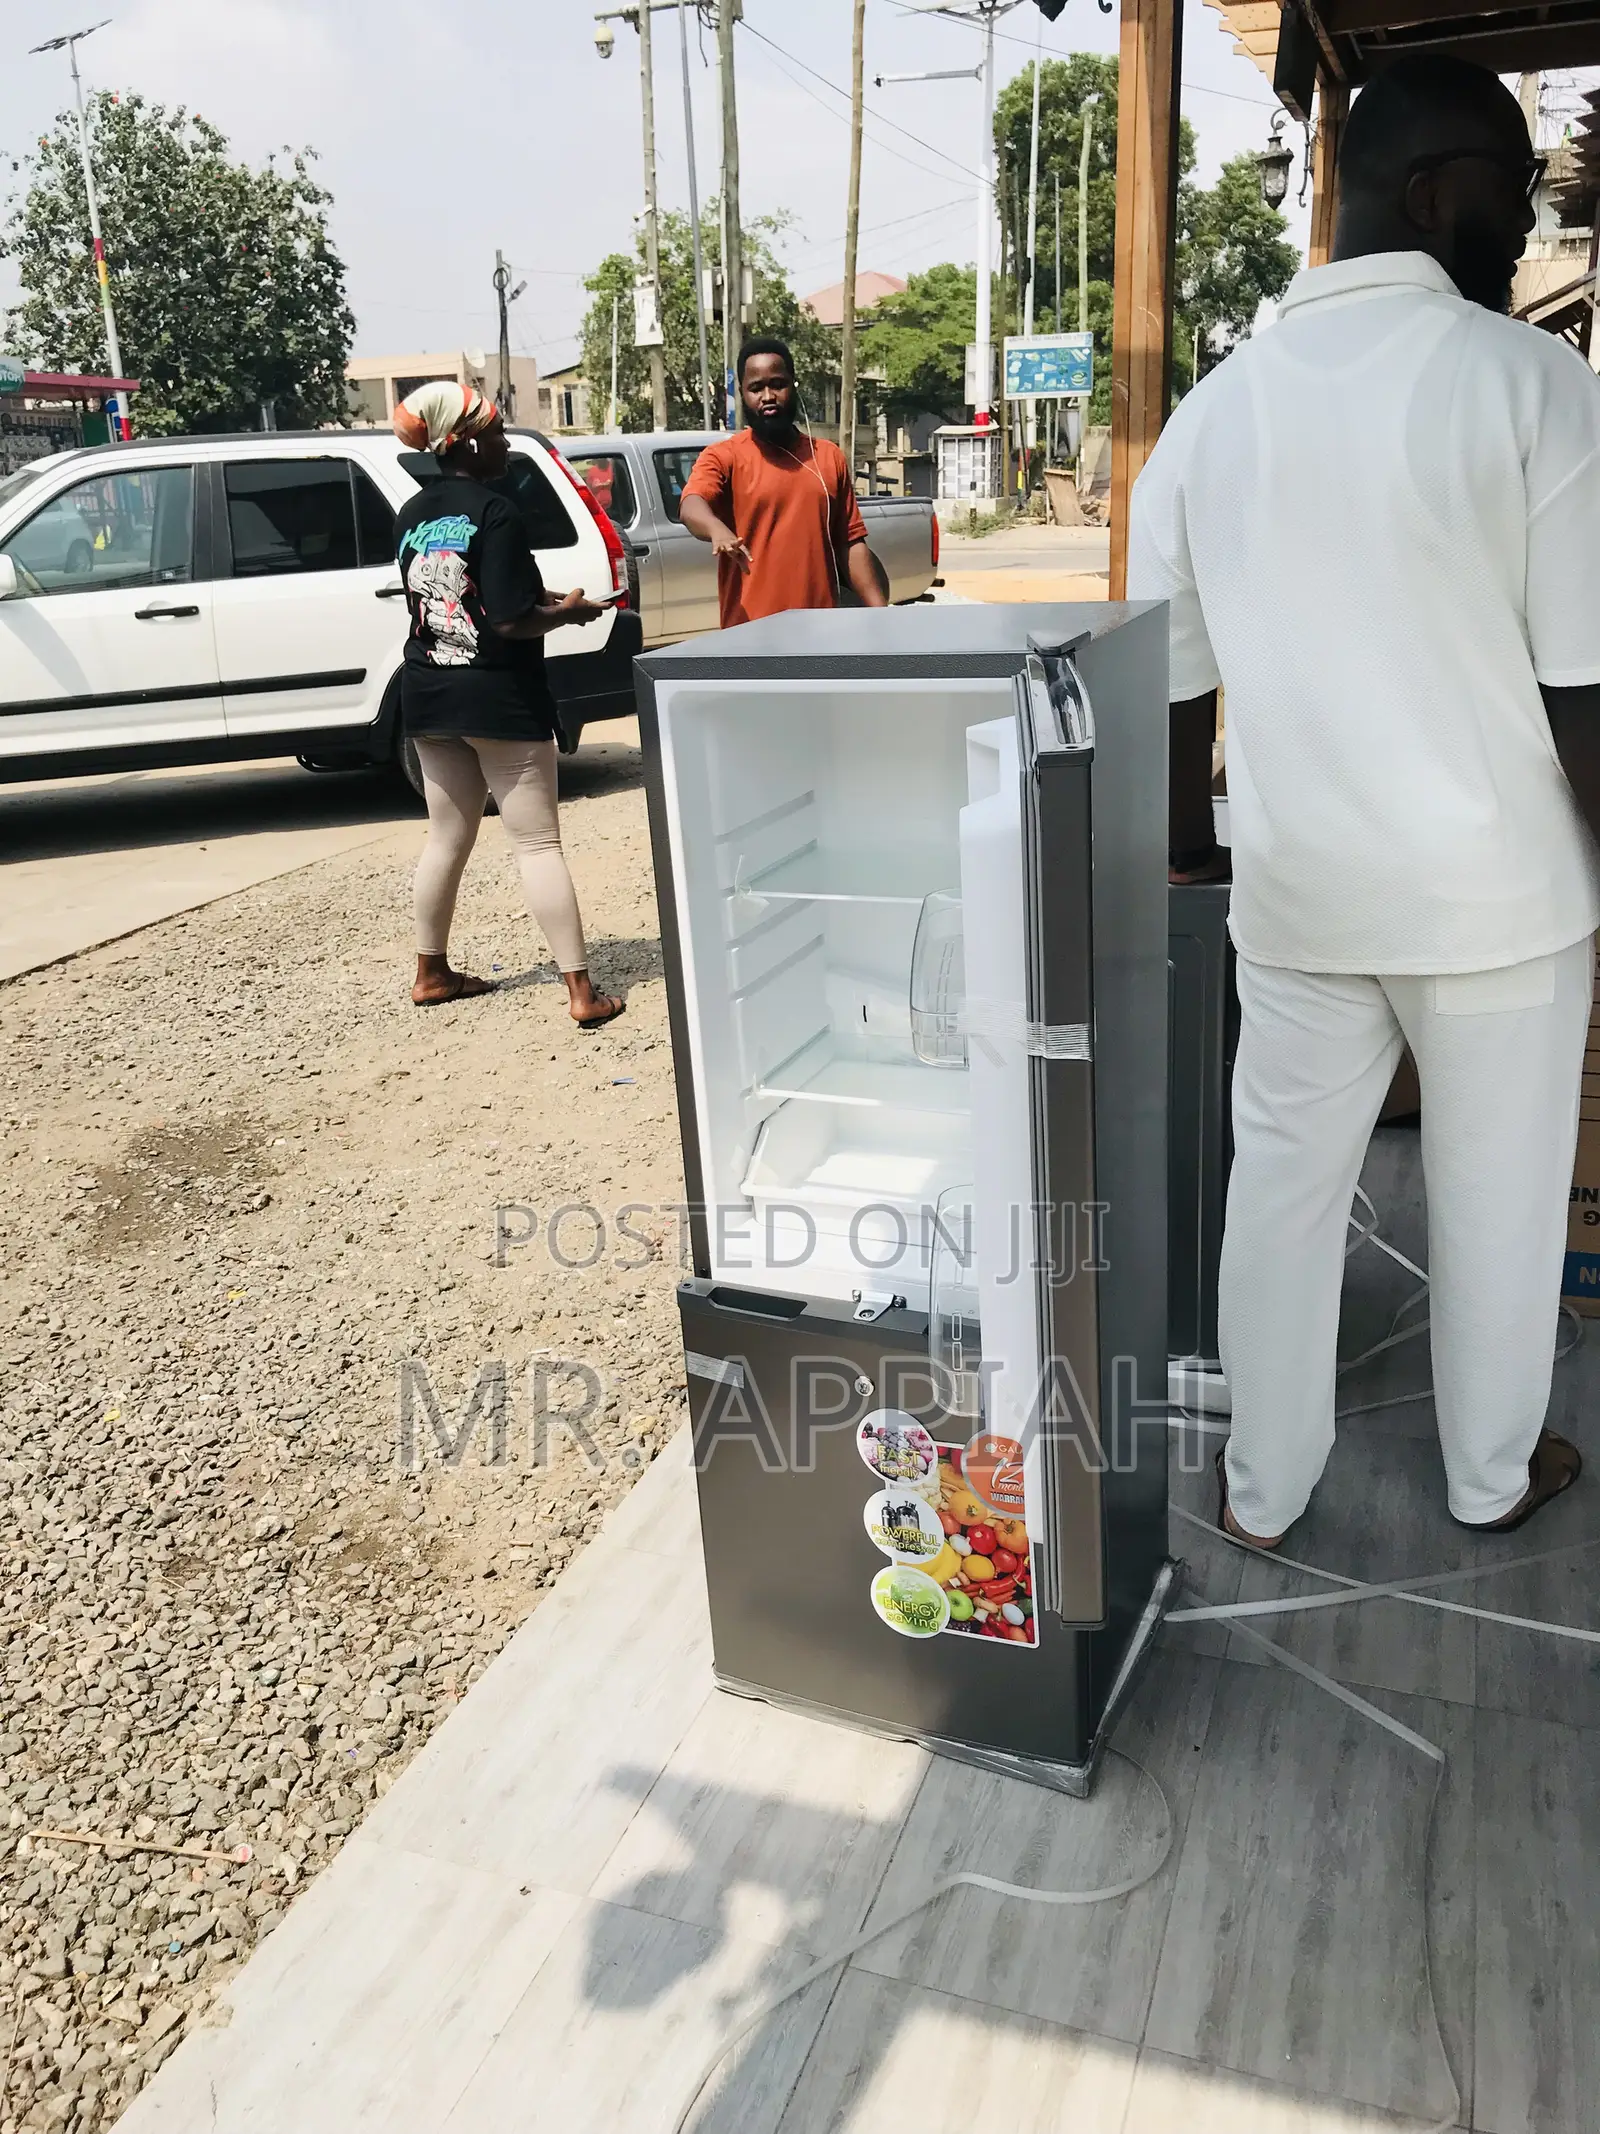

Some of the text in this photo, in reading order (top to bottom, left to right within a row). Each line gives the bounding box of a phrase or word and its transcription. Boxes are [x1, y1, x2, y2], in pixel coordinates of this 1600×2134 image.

[877, 1443, 921, 1466] FAST
[879, 1461, 920, 1481] friendly
[871, 1524, 941, 1547] POWERFUL
[875, 1537, 938, 1555] compressor
[884, 1597, 939, 1618] ENERGY
[886, 1612, 939, 1632] saving
